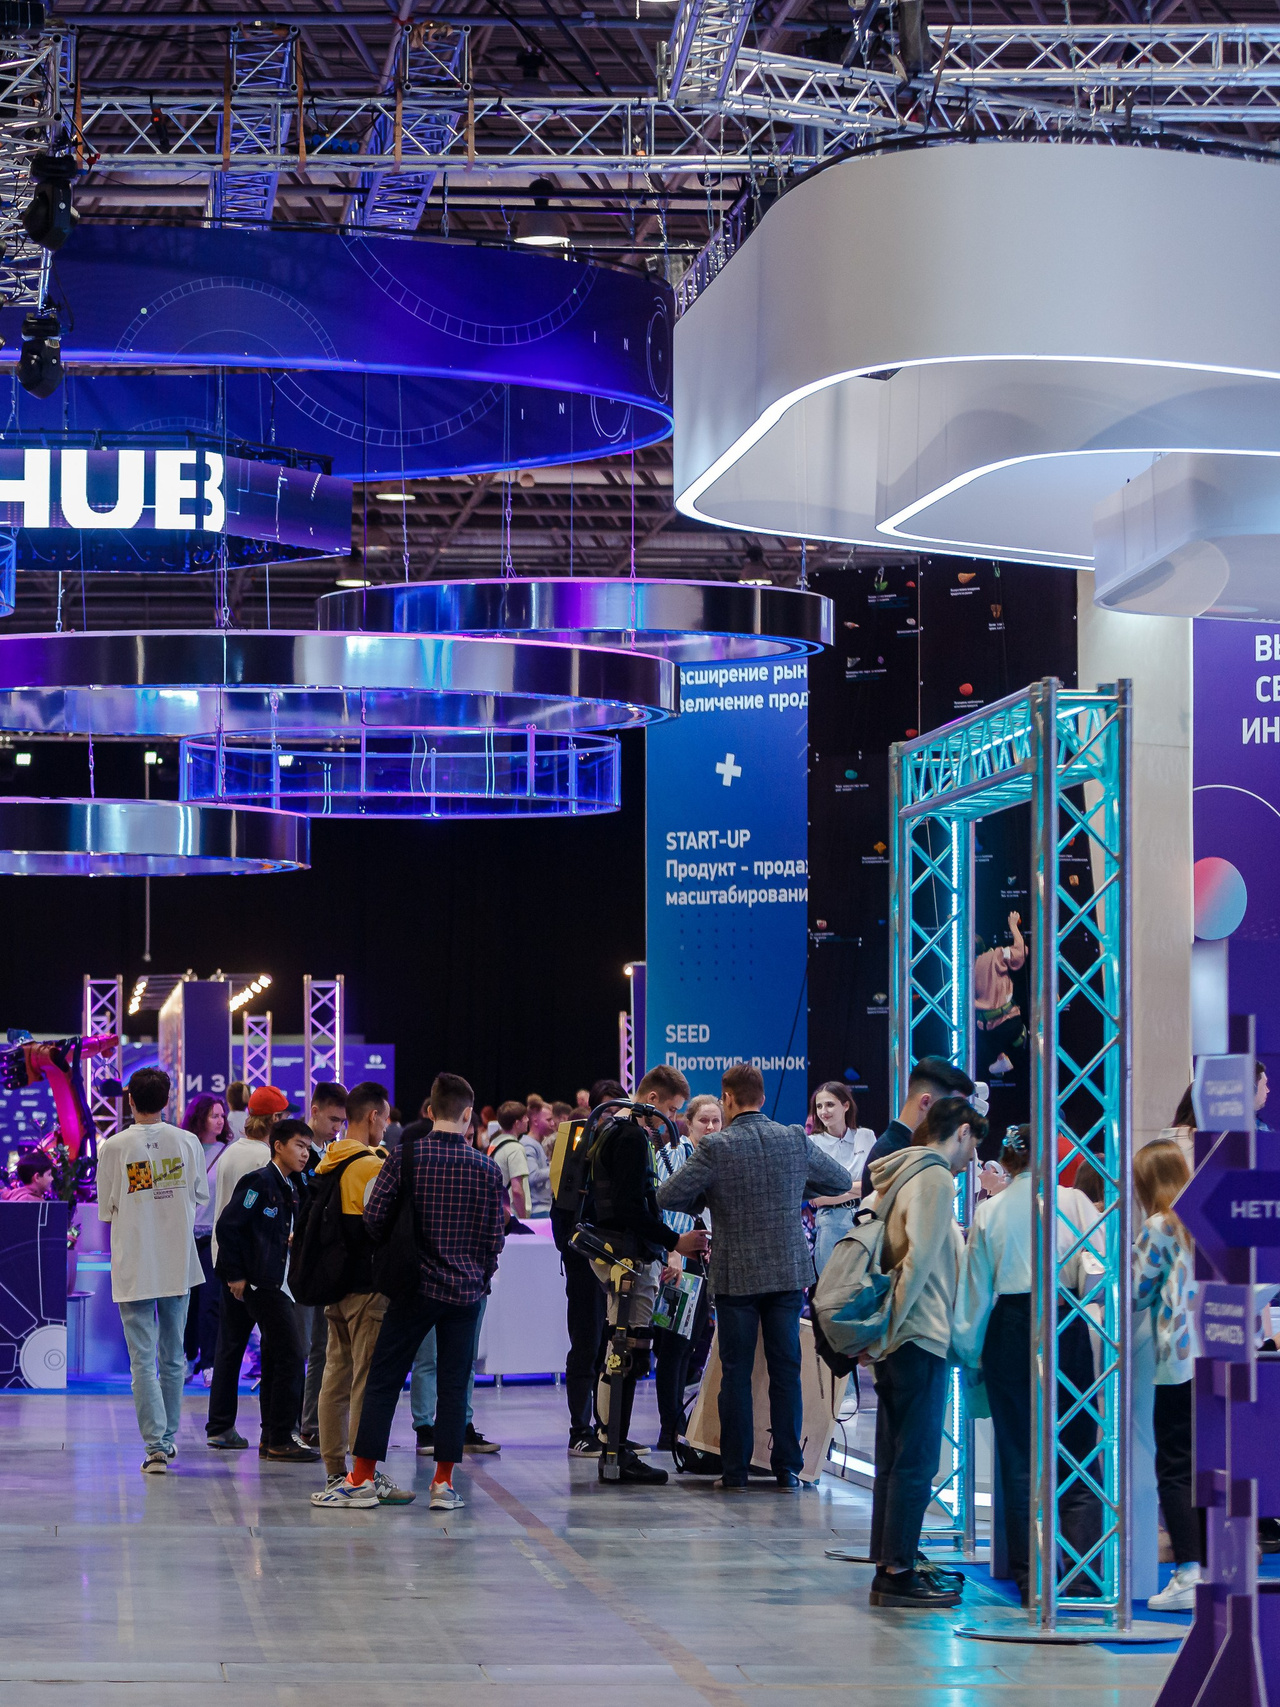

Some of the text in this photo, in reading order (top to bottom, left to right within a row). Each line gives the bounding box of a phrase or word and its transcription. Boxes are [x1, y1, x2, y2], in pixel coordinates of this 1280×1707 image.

[773, 664, 808, 685] рын
[666, 829, 751, 851] START-UP
[666, 859, 737, 882] Продукт
[753, 859, 808, 880] прода
[666, 885, 808, 908] масштабировани
[665, 1024, 711, 1043] SEED
